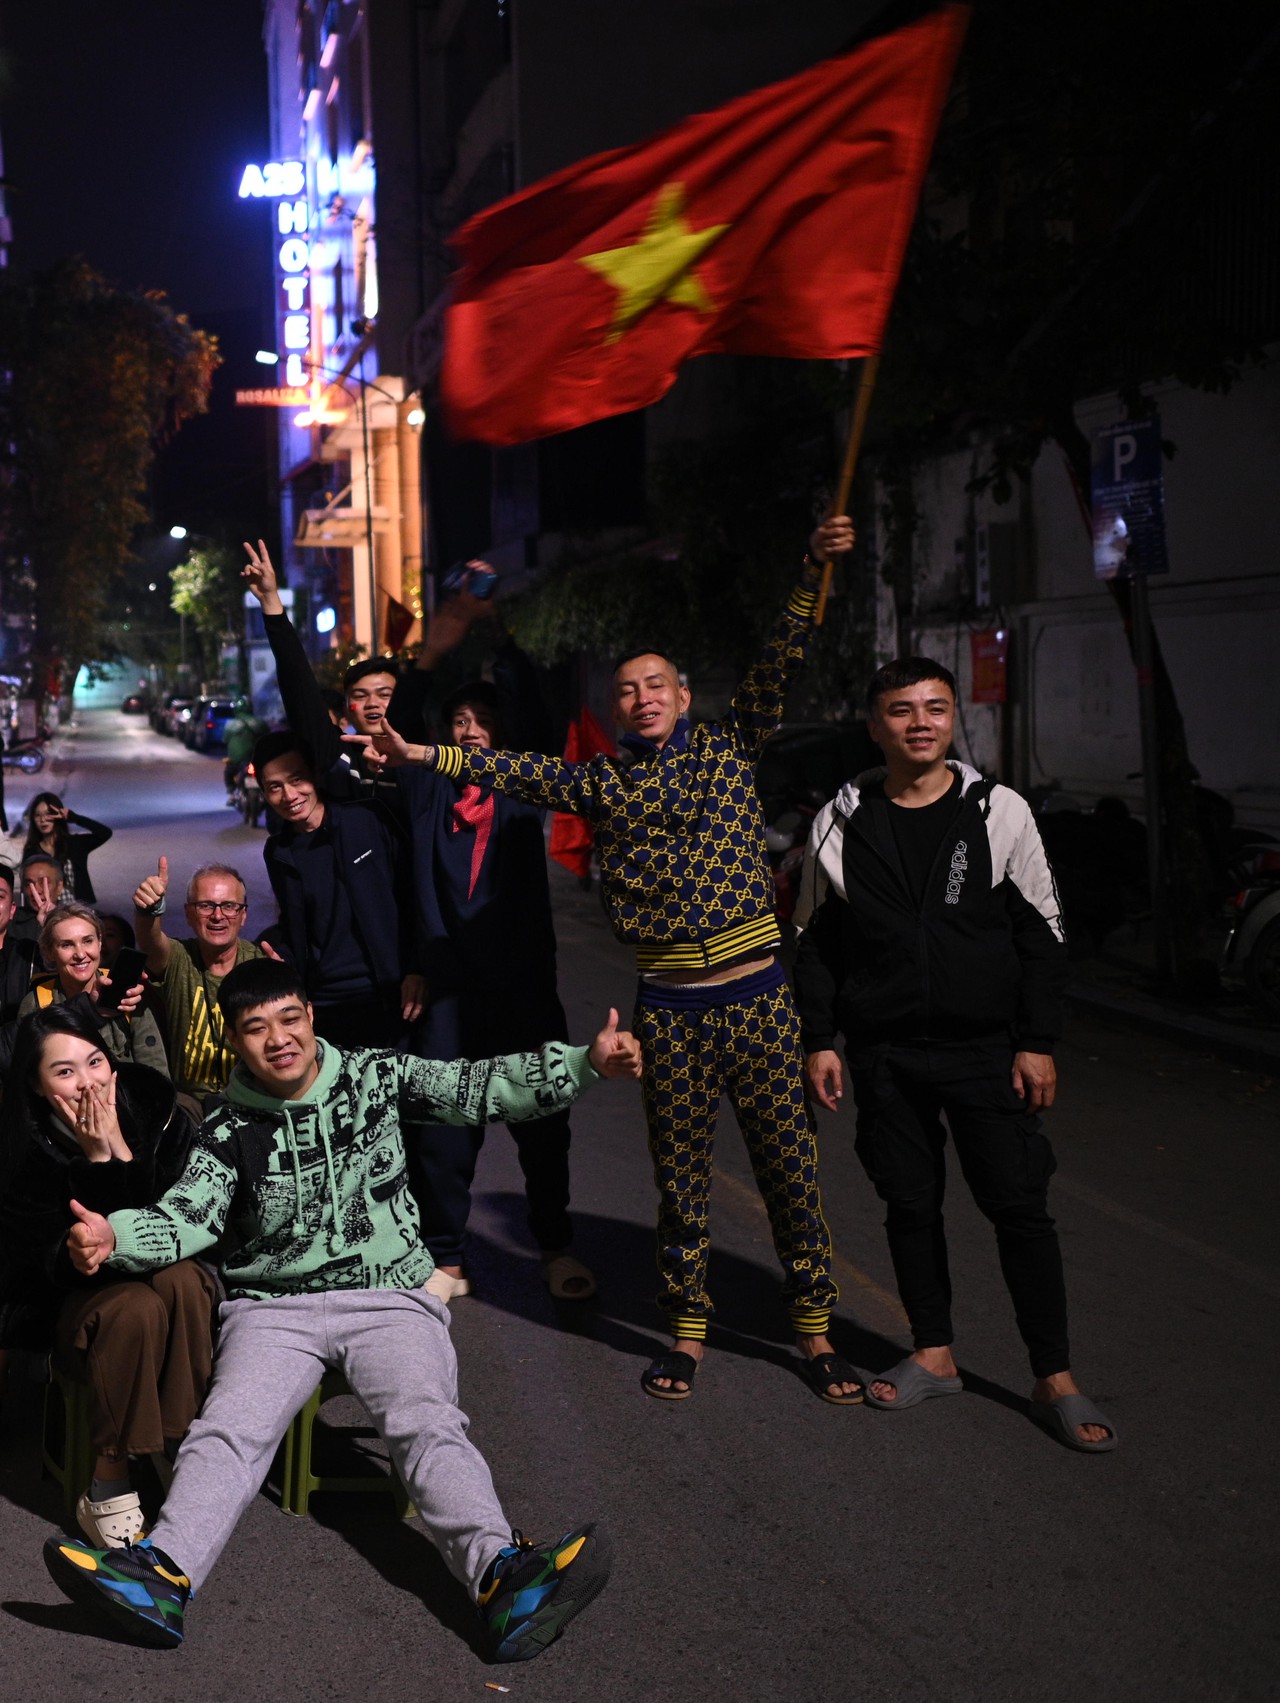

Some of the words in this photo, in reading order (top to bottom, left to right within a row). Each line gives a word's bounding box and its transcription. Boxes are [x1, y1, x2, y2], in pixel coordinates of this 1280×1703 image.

[238, 161, 305, 198] A25
[278, 201, 310, 387] HOTEL
[1113, 434, 1138, 482] P
[944, 840, 969, 905] adidas
